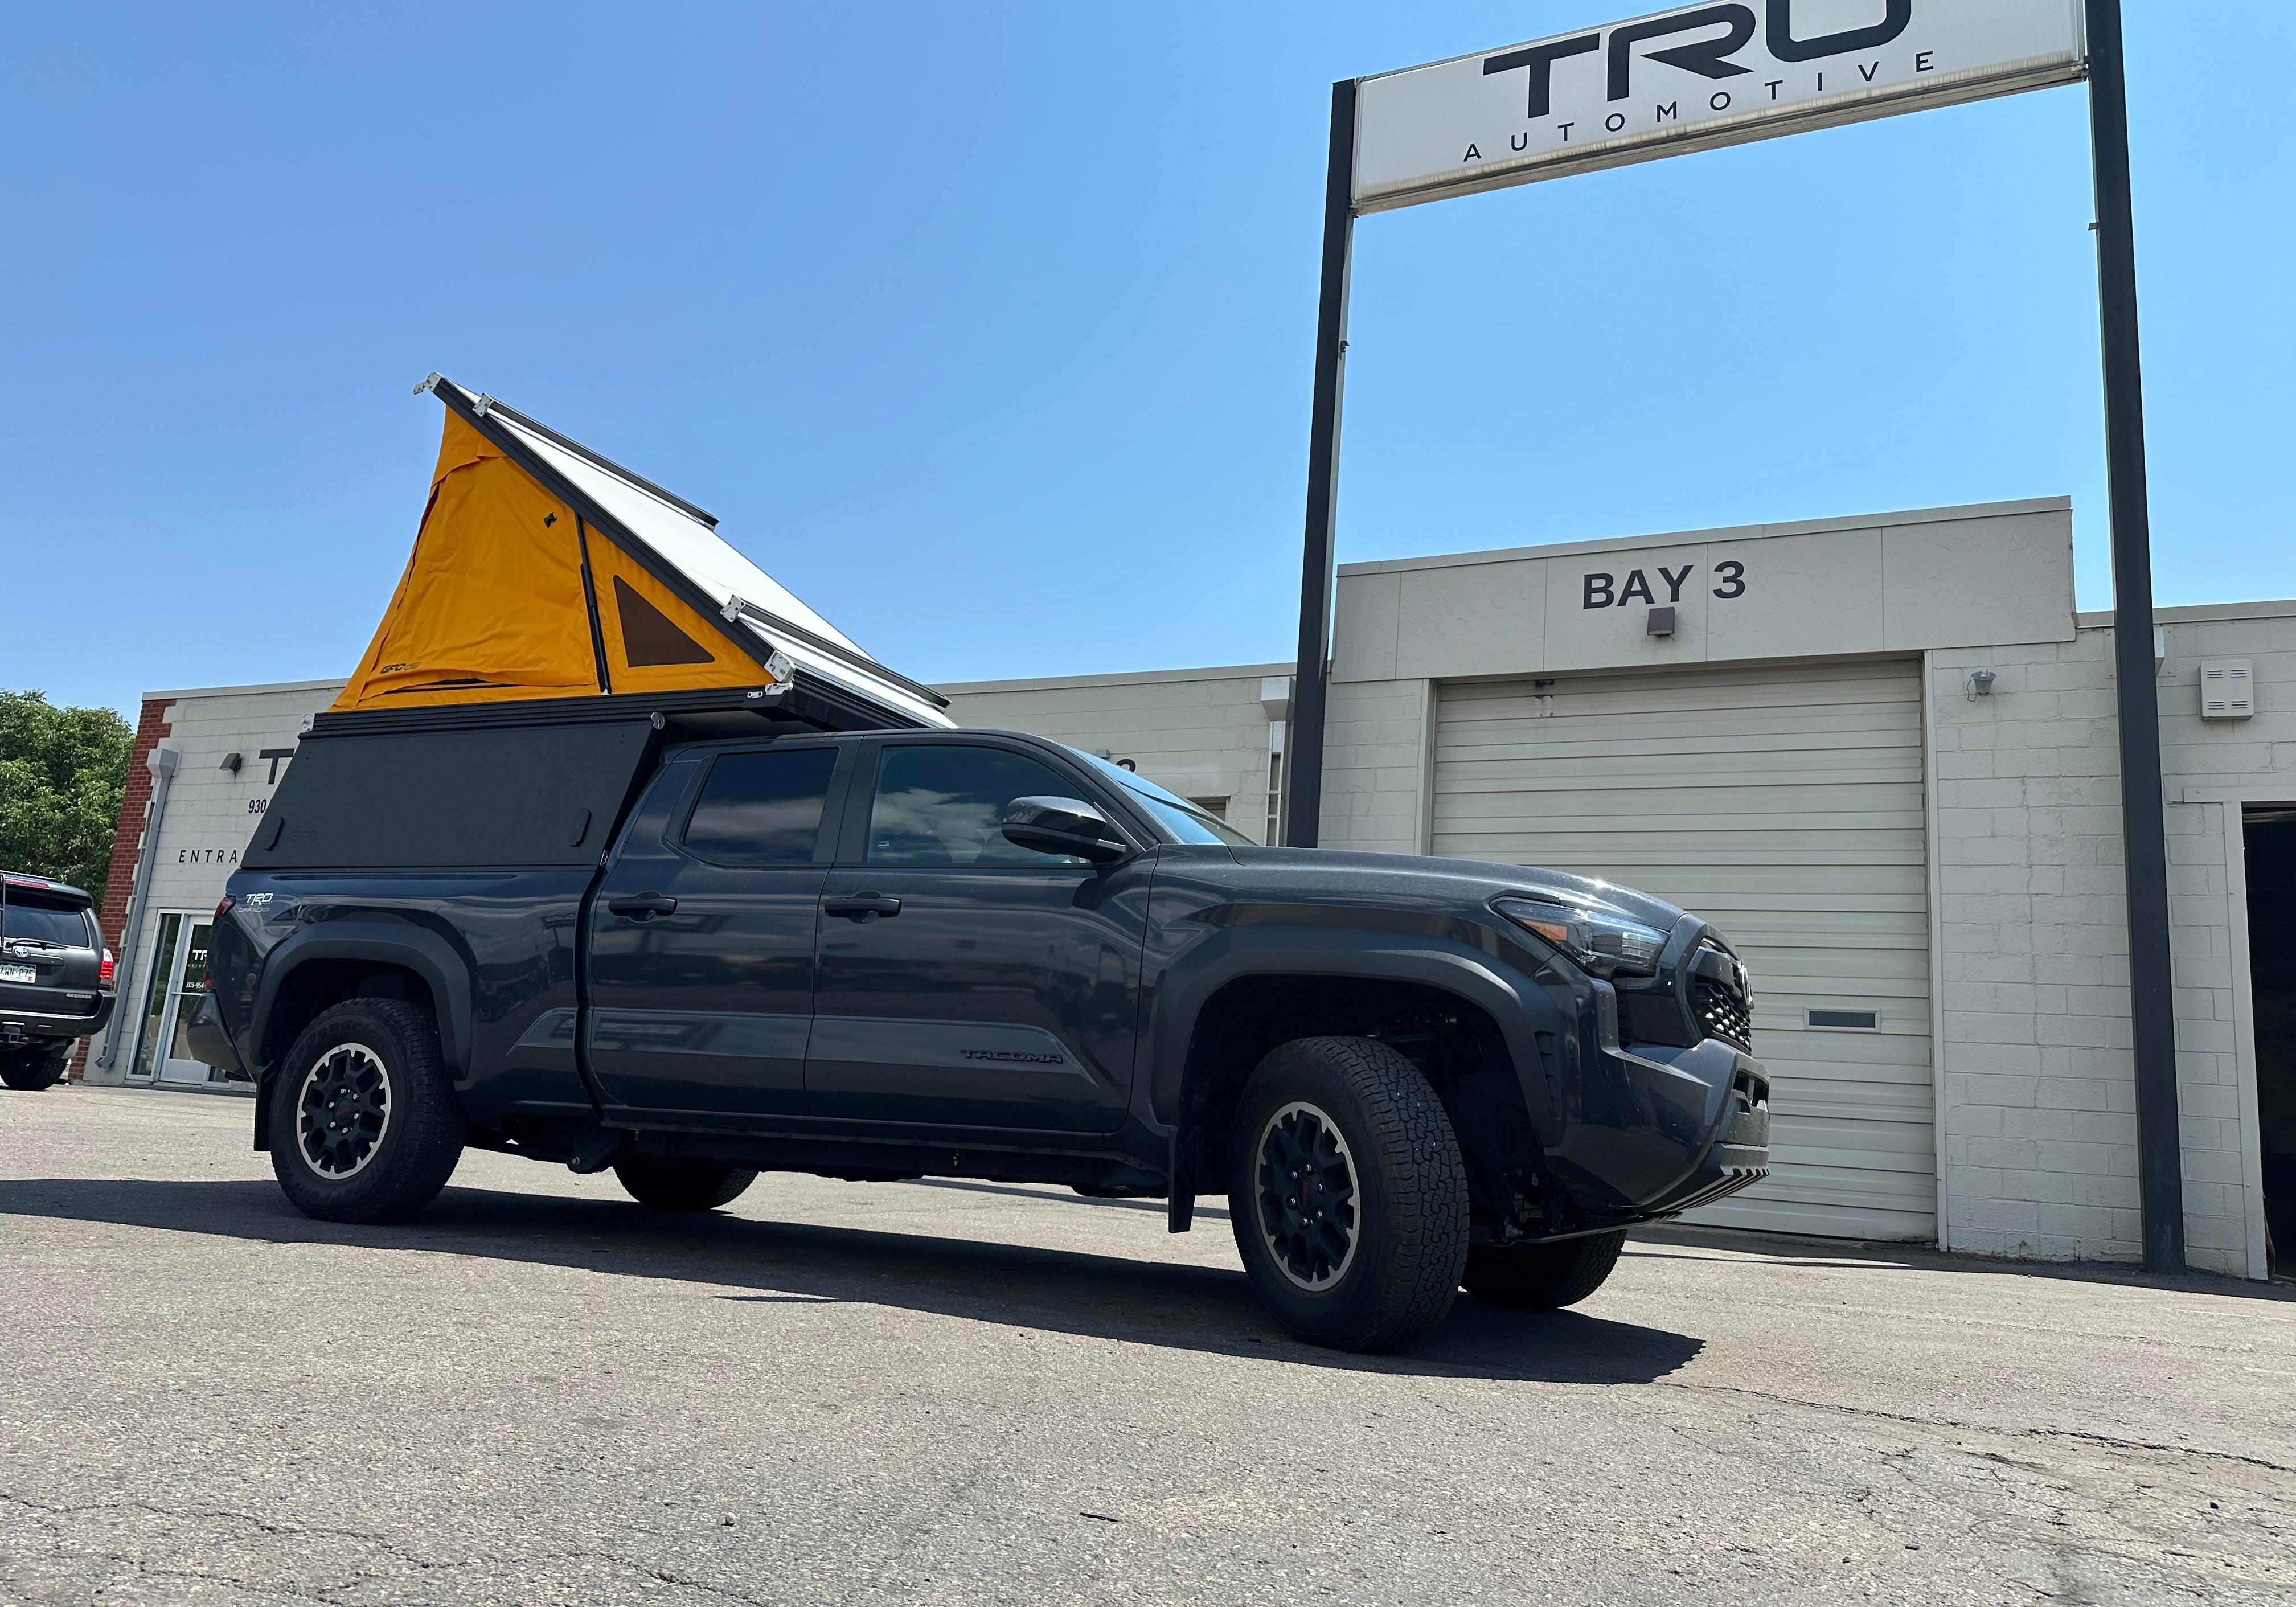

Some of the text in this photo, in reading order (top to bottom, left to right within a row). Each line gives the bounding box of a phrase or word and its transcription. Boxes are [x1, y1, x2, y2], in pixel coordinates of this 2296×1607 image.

[1463, 50, 1934, 162] AUTOMOTIVE
[1583, 560, 1746, 610] BAY 3
[259, 748, 295, 785] T
[248, 798, 267, 814] 930
[178, 849, 237, 863] ENTRA
[246, 892, 274, 906] TRD
[960, 1049, 1063, 1064] TACOMA
